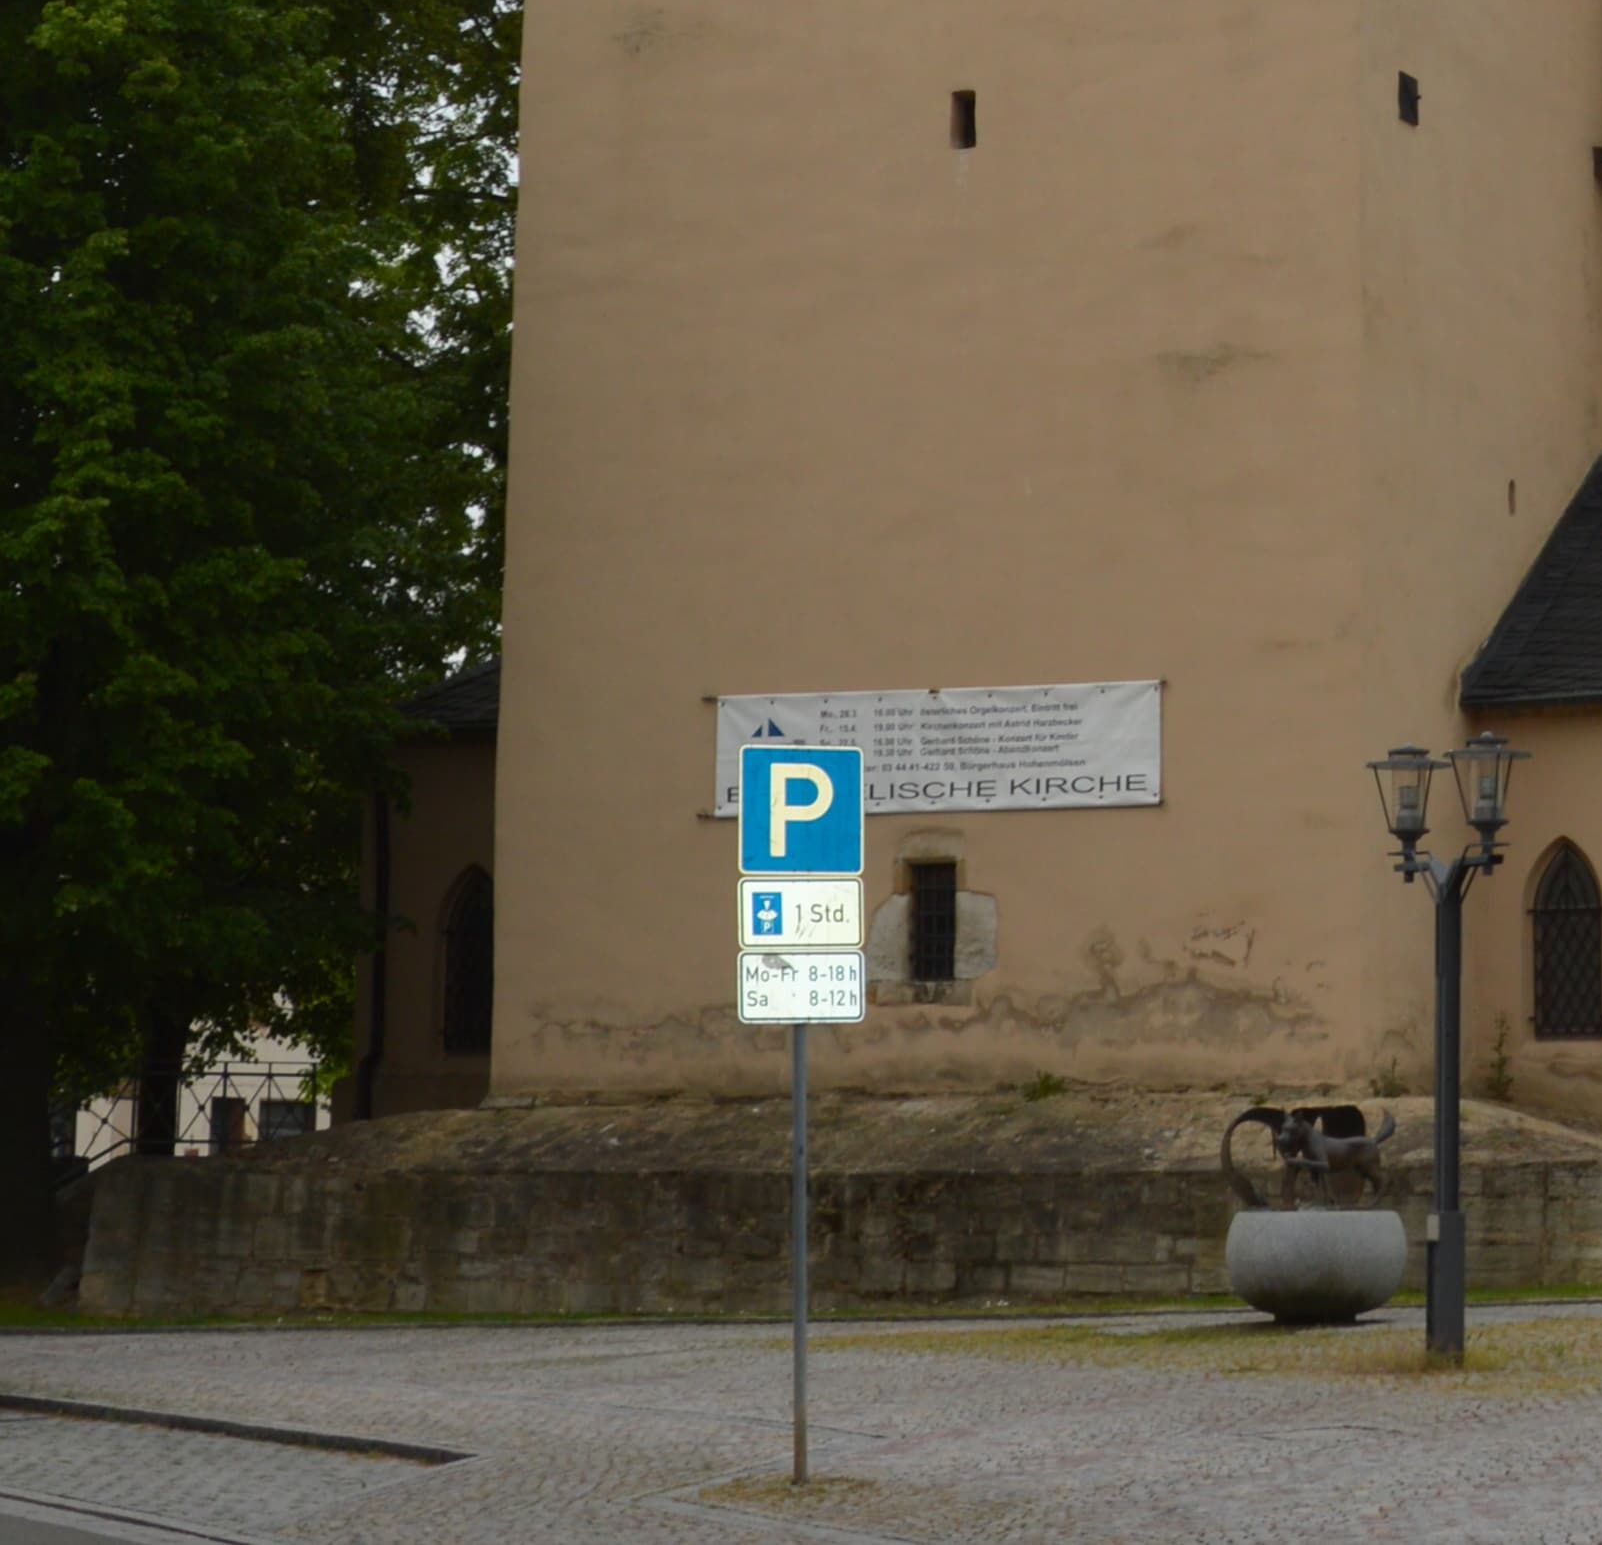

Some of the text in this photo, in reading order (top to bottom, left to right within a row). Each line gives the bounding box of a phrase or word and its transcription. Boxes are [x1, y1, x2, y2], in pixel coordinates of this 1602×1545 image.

[1010, 773, 1148, 796] KIRCHE
[770, 762, 834, 858] P
[810, 904, 850, 923] Std.
[746, 965, 857, 982] Mo-Fr 8-18 h
[746, 990, 857, 1007] Sa 8-12 h
